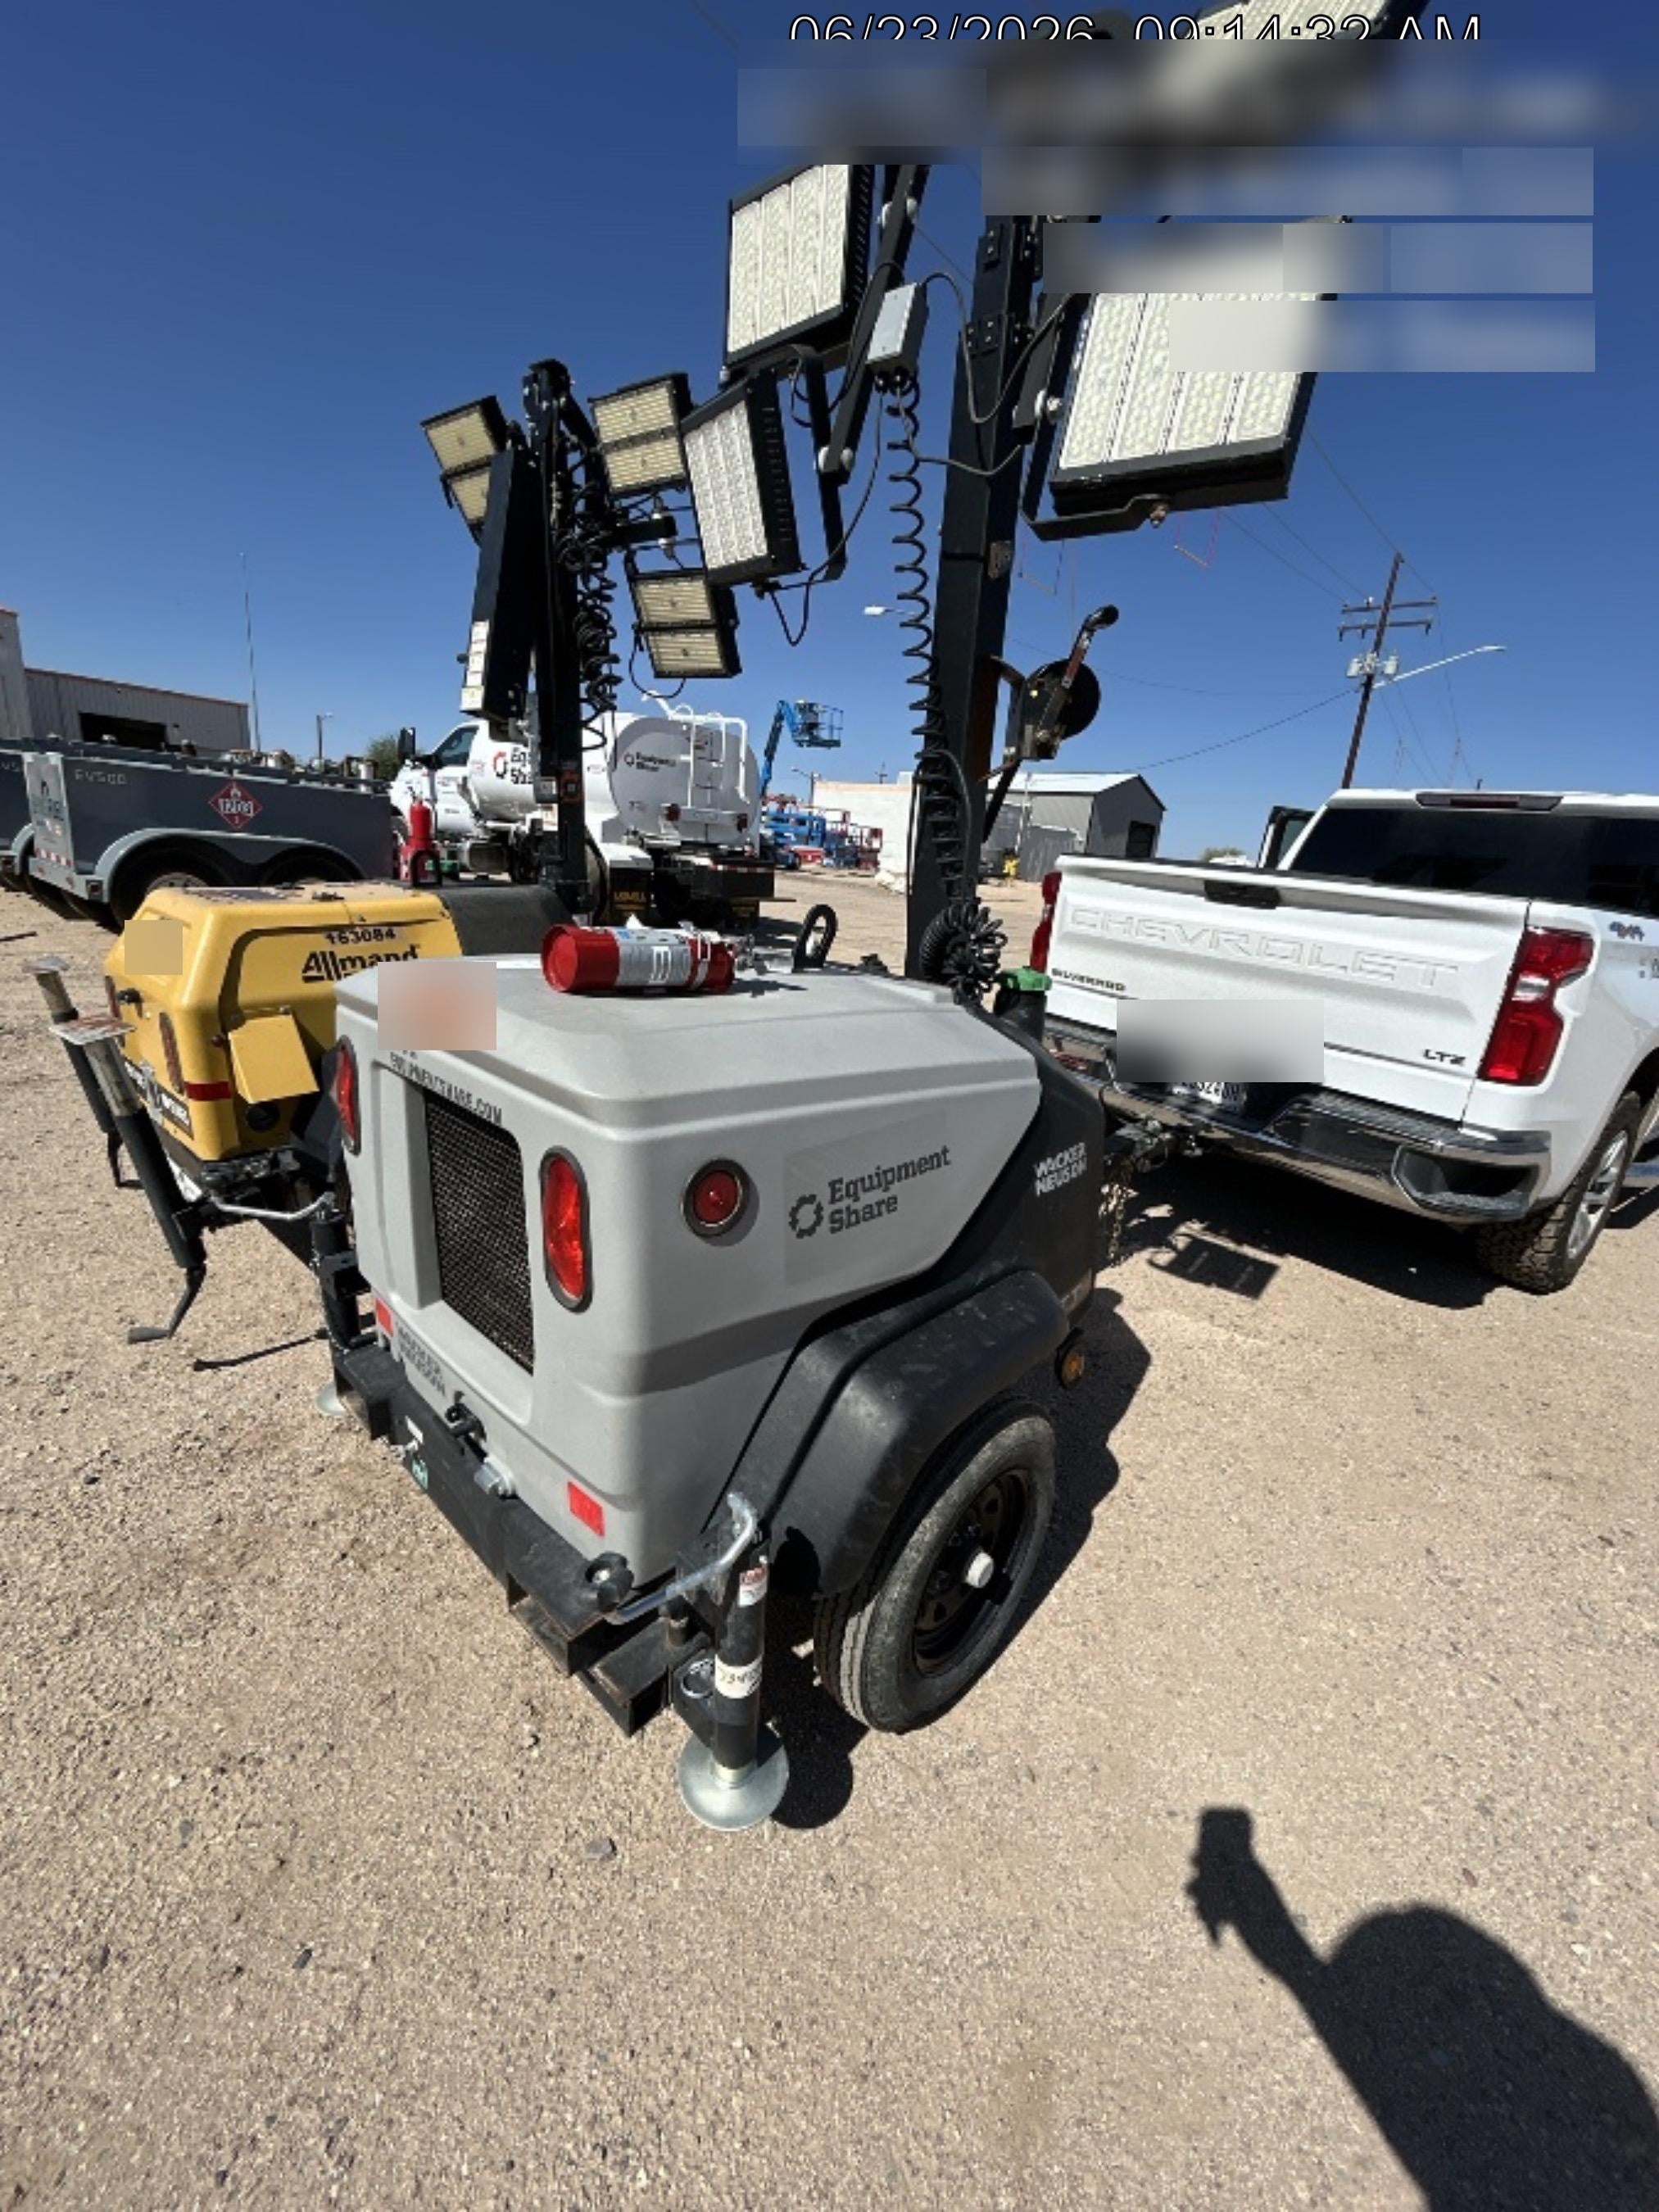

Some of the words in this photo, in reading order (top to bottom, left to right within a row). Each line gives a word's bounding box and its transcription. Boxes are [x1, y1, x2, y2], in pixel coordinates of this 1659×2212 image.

[1070, 907, 1459, 989] CHEVROLET
[1424, 1049, 1466, 1065] LTZ
[827, 1145, 952, 1204] Equipment
[828, 1194, 898, 1235] Share
